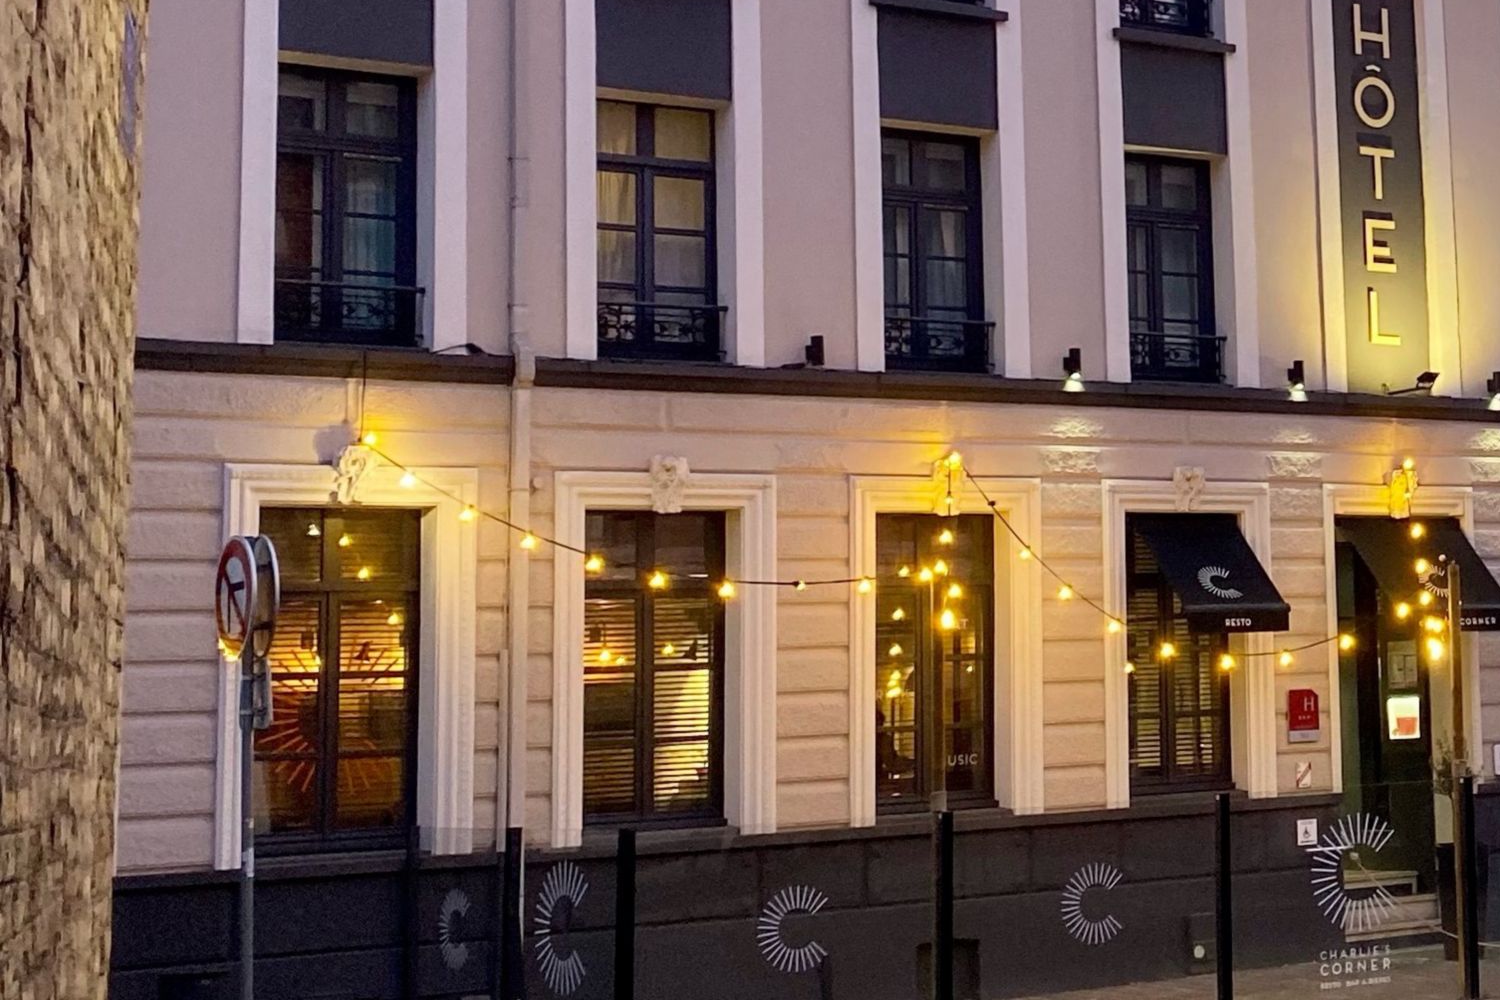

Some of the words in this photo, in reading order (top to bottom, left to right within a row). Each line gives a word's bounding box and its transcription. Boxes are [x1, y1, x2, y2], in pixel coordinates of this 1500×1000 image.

[1353, 3, 1402, 346] HÔTEL
[1225, 618, 1252, 627] RESTO
[1460, 616, 1496, 626] CORNER
[1303, 696, 1315, 711] H
[947, 753, 978, 767] USIC
[1320, 944, 1392, 961] CHARLIE'S
[1320, 957, 1391, 977] CORNER
